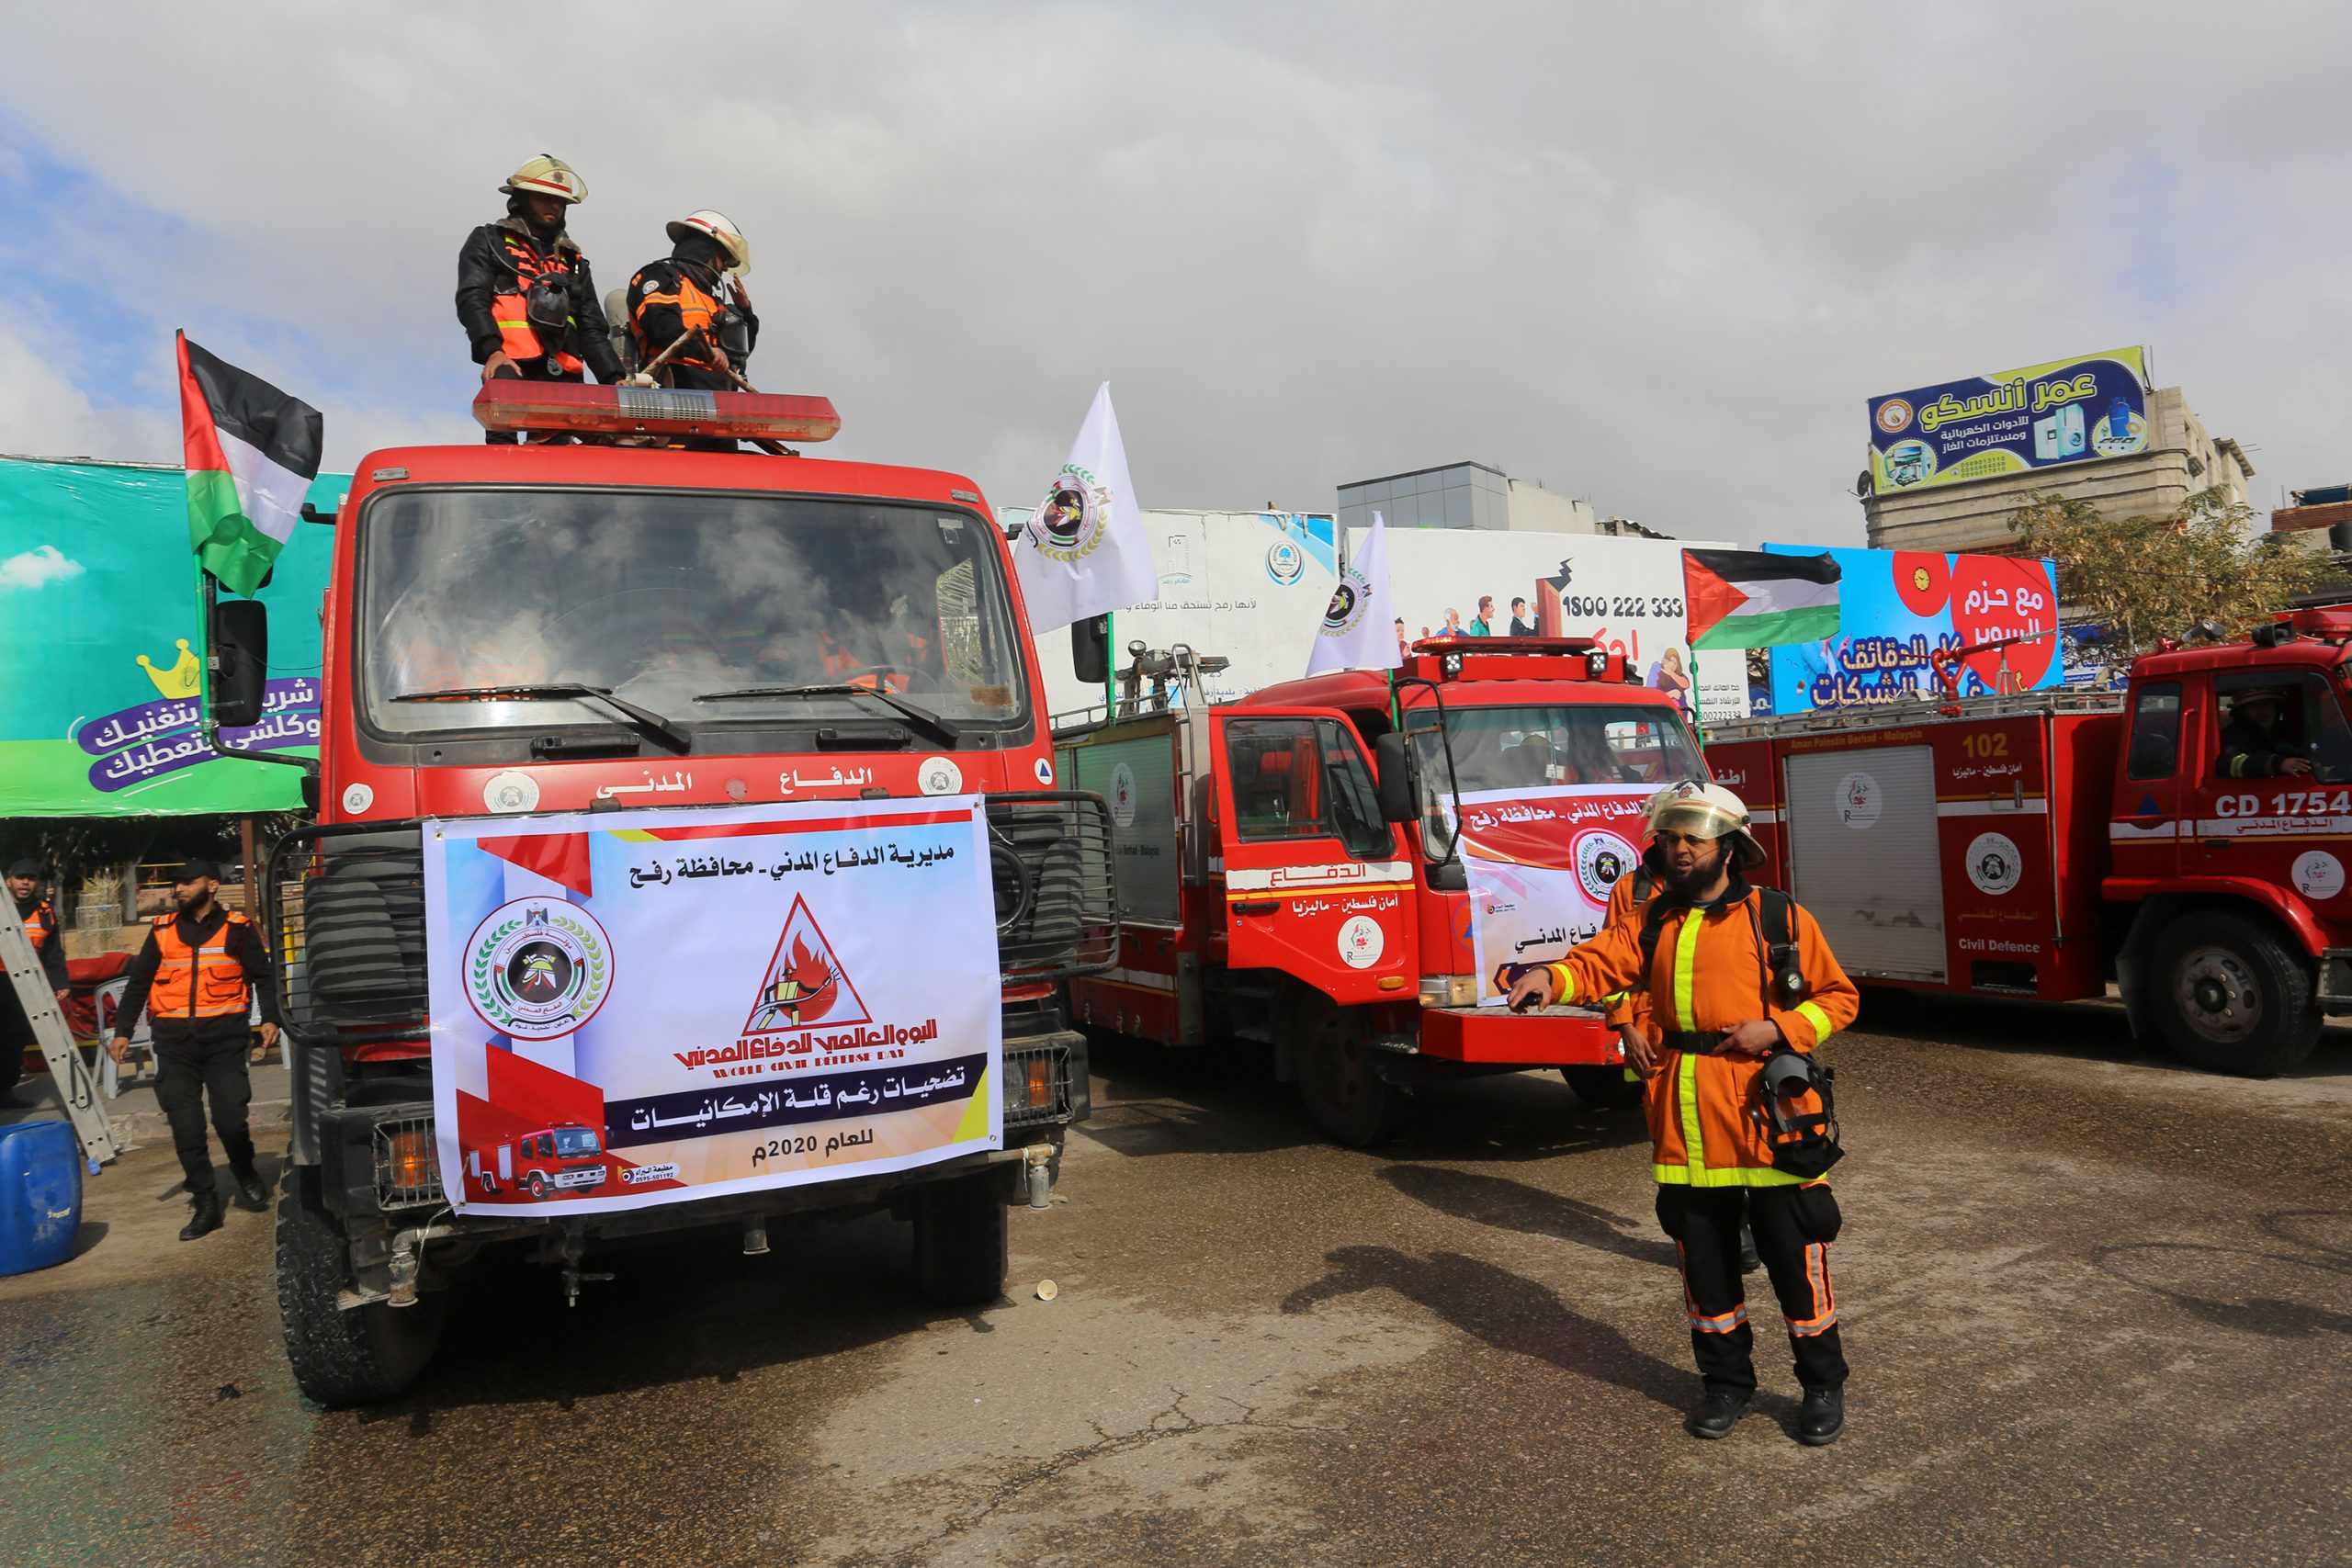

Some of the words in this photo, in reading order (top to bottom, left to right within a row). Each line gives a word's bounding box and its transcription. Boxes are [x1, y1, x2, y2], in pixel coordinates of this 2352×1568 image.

[1919, 376, 2027, 433] أنسكو
[2033, 374, 2098, 412] عمر
[1942, 441, 1964, 454] الغاز
[1967, 432, 2026, 448] ومستلزمات
[1164, 602, 1178, 610] منا
[1180, 601, 1212, 610] تستحق
[1215, 602, 1233, 612] رفح
[1235, 598, 1257, 609] لأنها
[1562, 595, 1608, 616] 1800
[1612, 597, 1646, 617] 222
[1651, 597, 1684, 618] 333
[1964, 581, 2009, 615] حزم
[2016, 586, 2043, 616] مع
[1843, 638, 1926, 670] الدقائق
[95, 702, 201, 748] بتغنيك
[1962, 732, 2008, 758] 102
[780, 765, 873, 795] الدفاع
[1717, 769, 1746, 789] إطف
[1497, 805, 1556, 823] محافظة
[1567, 802, 1600, 824] المدني
[2216, 795, 2259, 817] CD
[2271, 791, 2351, 815] 1754
[1470, 809, 1499, 831] رفح
[676, 855, 754, 879] محافظة
[770, 850, 819, 882] المدني
[824, 846, 885, 875] الدفاع
[889, 842, 955, 869] مديرية
[630, 860, 673, 888] رفح
[1271, 863, 1366, 886] الدفاع
[1292, 899, 1329, 917] ماليزيا
[1341, 895, 1377, 914] فلسطين
[1379, 893, 1398, 910] أمان
[1515, 927, 1566, 954] المدني
[1959, 939, 1984, 950] Civil
[1989, 940, 2041, 953] Defence
[750, 1032, 812, 1059] للدفاع
[813, 1023, 895, 1055] العالمي
[896, 1019, 938, 1047] اليوم
[673, 1040, 748, 1070] المدني
[713, 1064, 765, 1078] WORLD
[770, 1059, 808, 1073] CIVIL
[815, 1053, 873, 1066] DEFENSE
[878, 1048, 906, 1062] DAY
[785, 1083, 831, 1109] قلة
[837, 1079, 879, 1110] رغم
[883, 1066, 966, 1099] تضحيات
[631, 1091, 780, 1131] الإمكانيات
[826, 1128, 874, 1157] للعام
